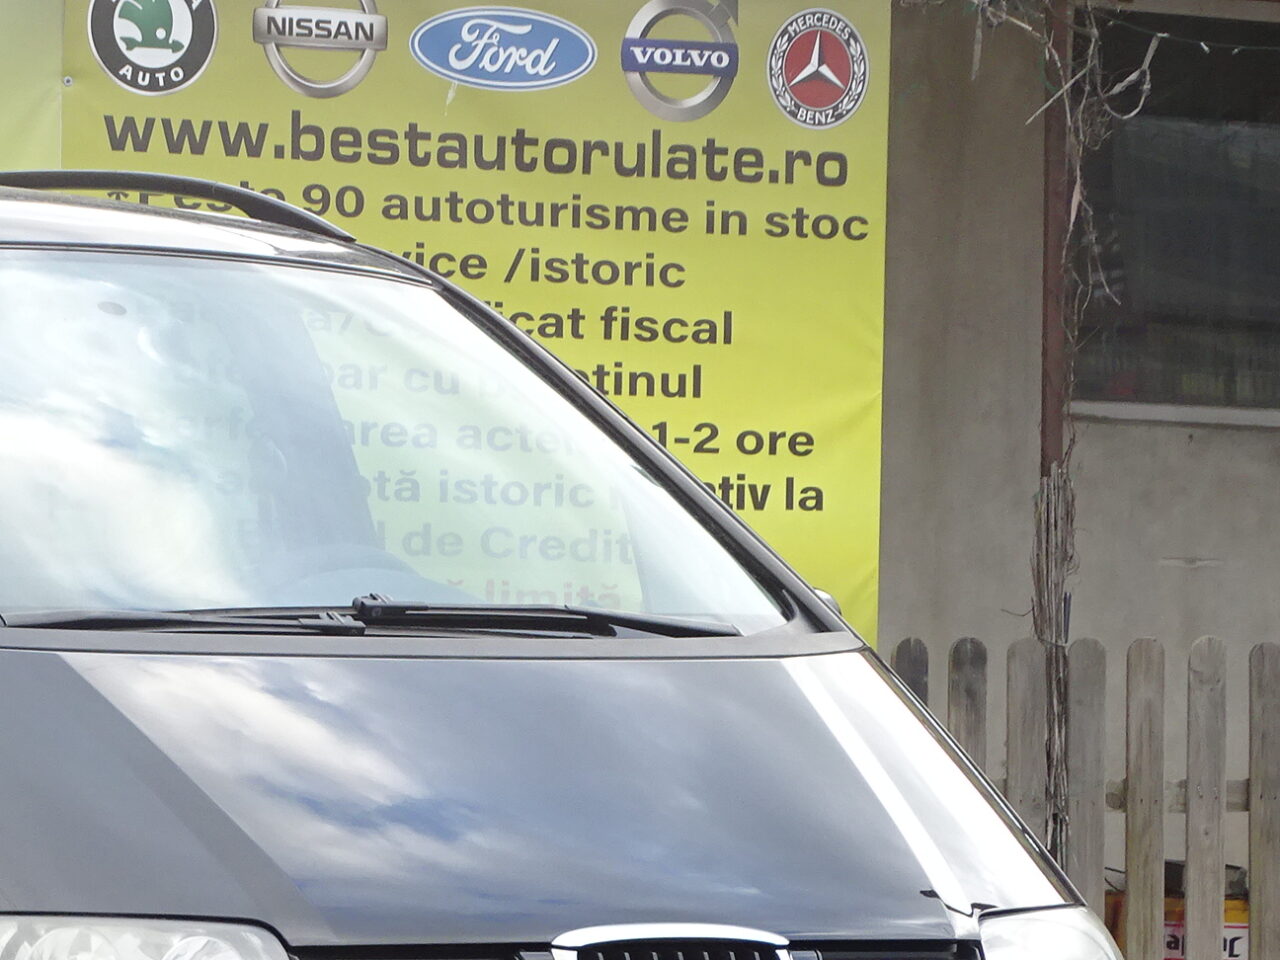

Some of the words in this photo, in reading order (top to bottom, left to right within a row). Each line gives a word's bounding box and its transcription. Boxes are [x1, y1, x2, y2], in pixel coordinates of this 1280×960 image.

[266, 16, 375, 42] NISSAN
[787, 13, 851, 40] MERCEDES
[448, 18, 561, 77] Ford
[630, 46, 730, 69] VOLVO
[118, 64, 185, 88] AUTO
[797, 108, 836, 125] BENZ
[103, 110, 849, 188] www.bestautorulate.ro
[302, 183, 365, 218] 90
[381, 191, 689, 234] autoturisme
[705, 200, 748, 236] in
[764, 207, 870, 241] stoc
[503, 247, 687, 289] /istoric
[600, 305, 734, 345] fiscal
[652, 421, 721, 454] 1-2
[736, 430, 815, 457] ore
[438, 469, 596, 508] istoric
[785, 476, 825, 511] la
[401, 523, 464, 557] de
[480, 526, 635, 566] Credit
